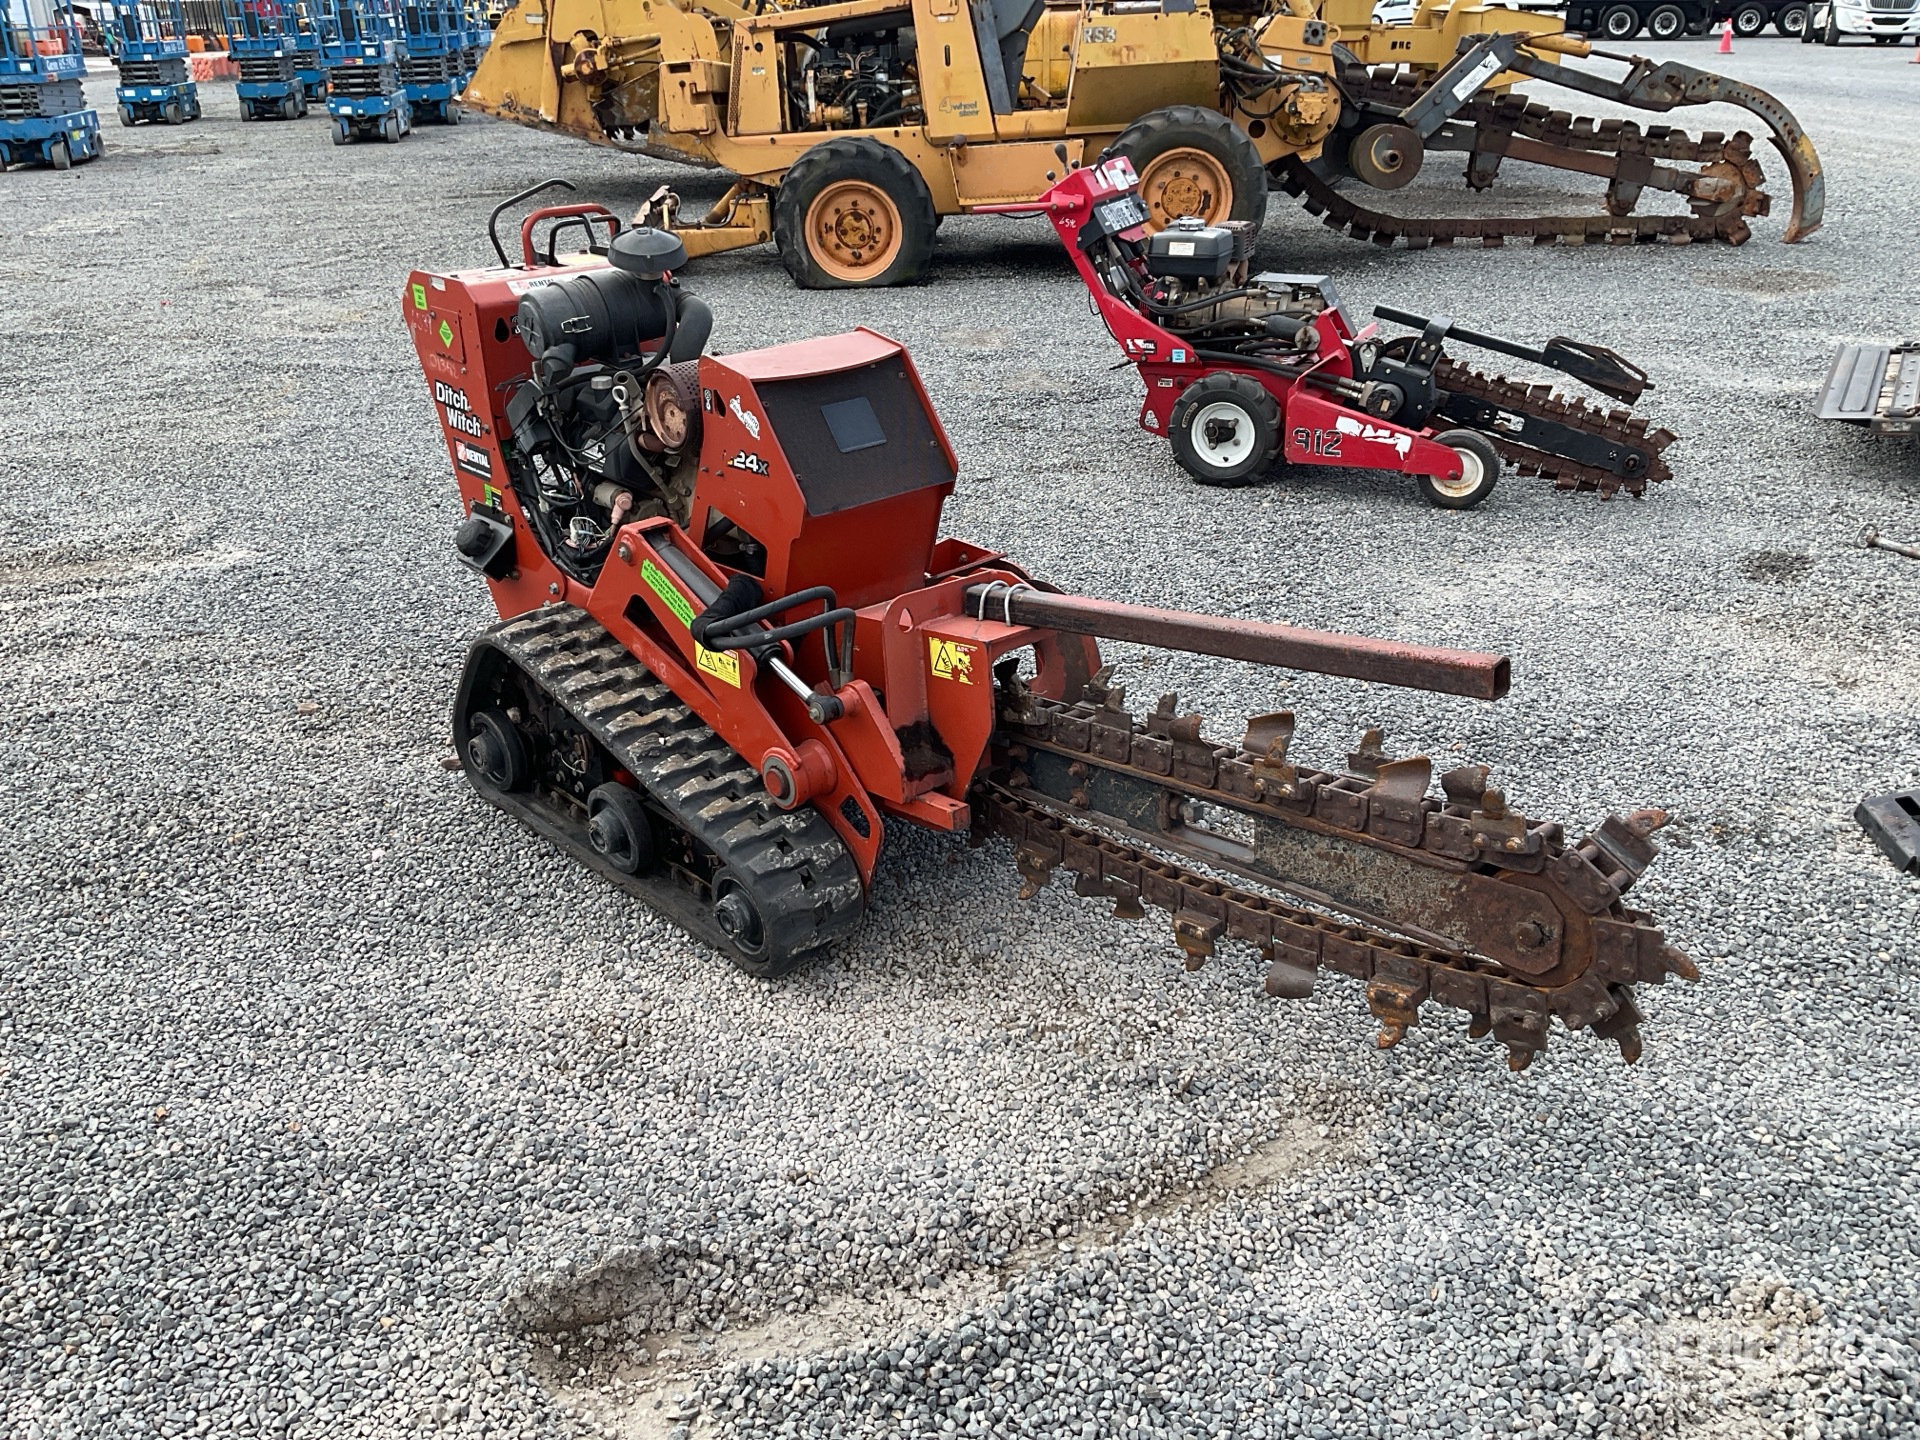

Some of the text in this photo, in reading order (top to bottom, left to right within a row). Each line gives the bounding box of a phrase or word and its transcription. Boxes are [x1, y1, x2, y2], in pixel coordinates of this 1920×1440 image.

[1083, 26, 1117, 43] RS3
[952, 101, 977, 110] wheel
[959, 109, 979, 117] steer
[436, 381, 468, 410] Ditch
[446, 407, 481, 437] Witch
[1292, 427, 1343, 457] 912
[677, 609, 689, 623] CLEAN
